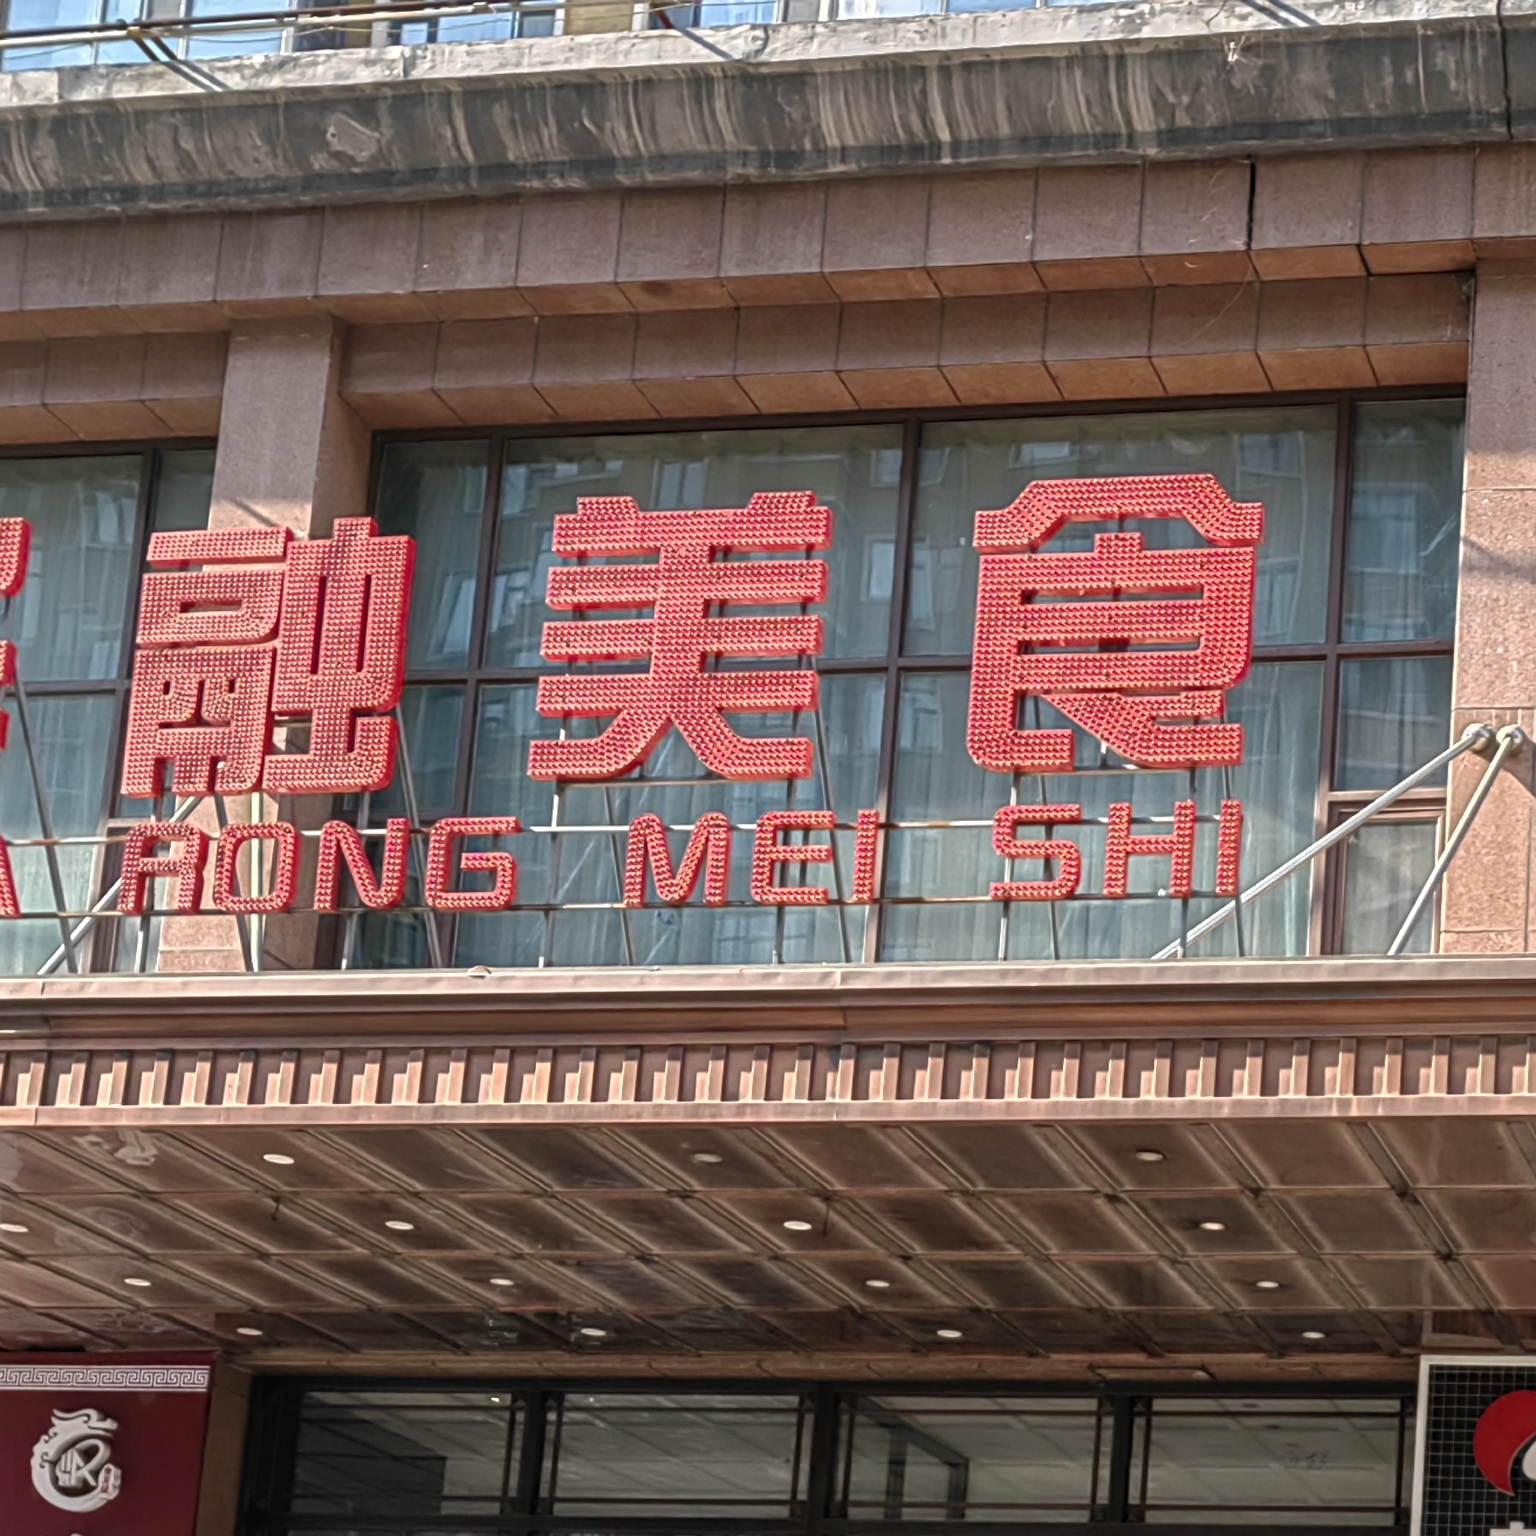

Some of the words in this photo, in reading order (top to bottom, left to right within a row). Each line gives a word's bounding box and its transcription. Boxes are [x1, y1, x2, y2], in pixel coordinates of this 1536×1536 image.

[0, 474, 1264, 798] 融美食
[116, 815, 520, 916] RONG
[622, 808, 880, 908] MEI
[989, 799, 1242, 901] SHI
